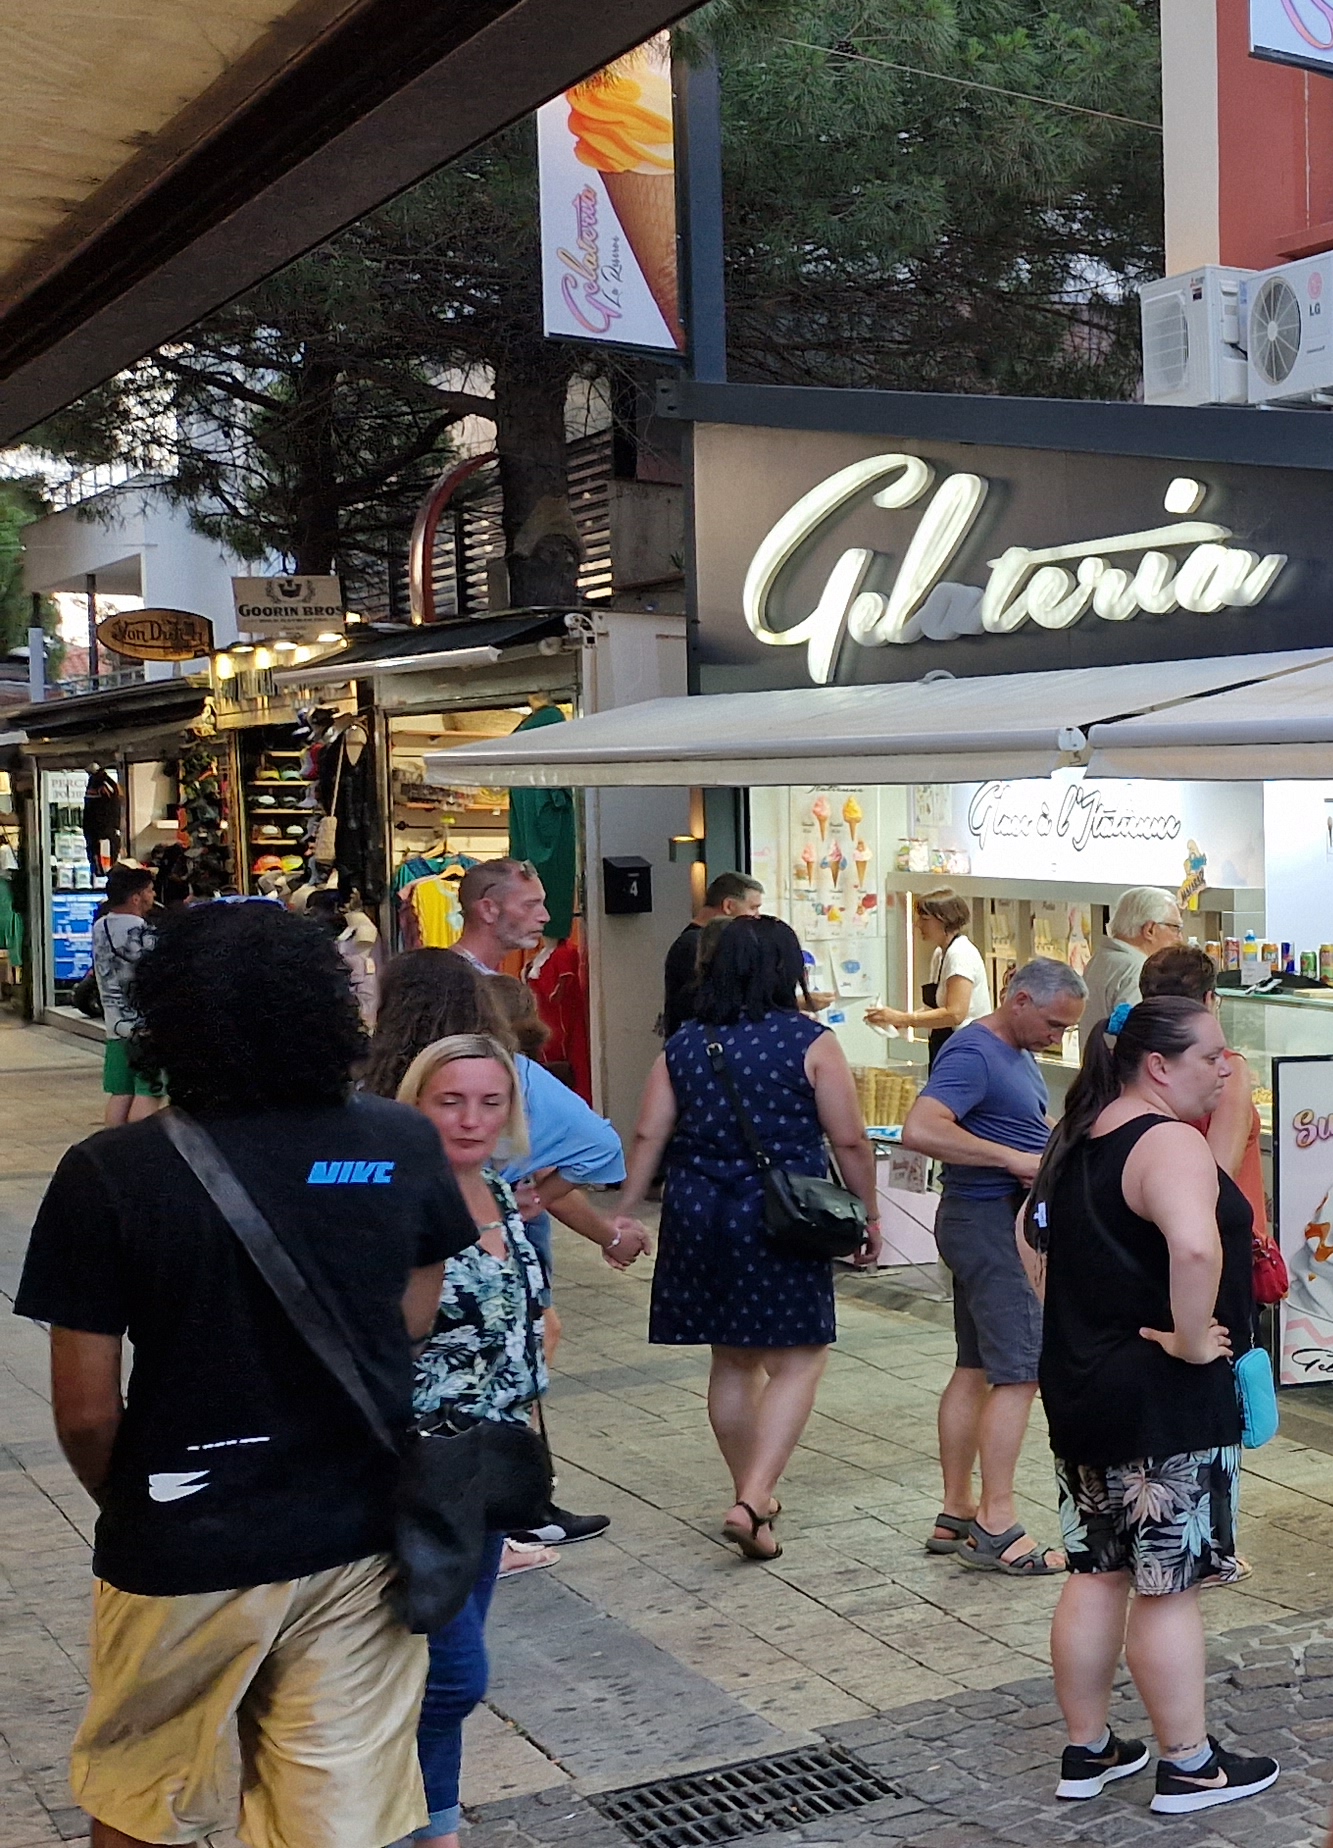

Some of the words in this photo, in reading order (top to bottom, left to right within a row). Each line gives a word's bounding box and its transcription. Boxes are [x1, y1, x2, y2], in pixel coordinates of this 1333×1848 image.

[557, 184, 622, 333] Gelateria
[1309, 303, 1321, 316] LG
[742, 453, 1288, 685] Gelateria
[239, 604, 298, 617] GOORIN
[630, 881, 638, 896] 4
[307, 1161, 394, 1184] NIKE
